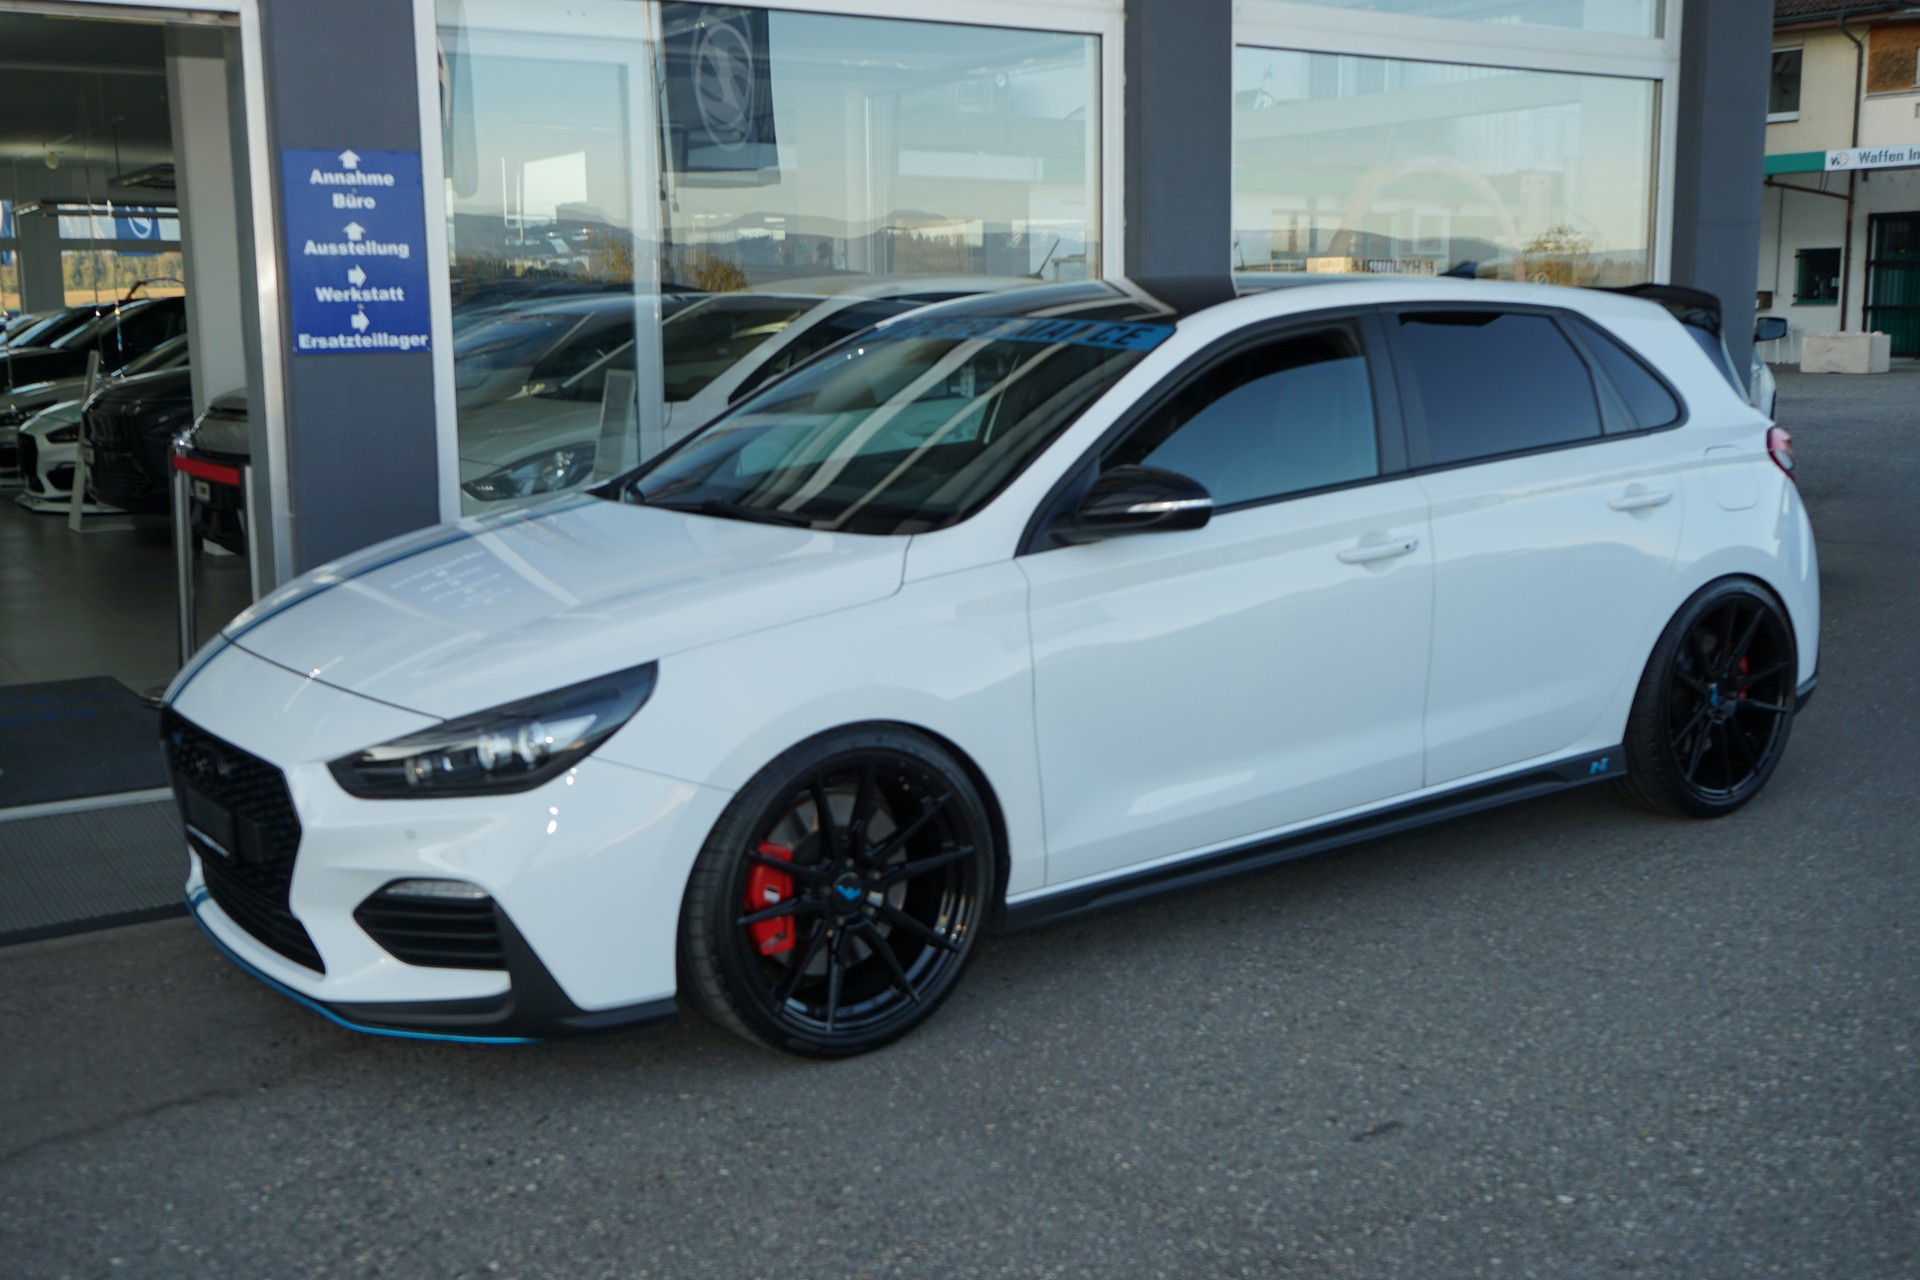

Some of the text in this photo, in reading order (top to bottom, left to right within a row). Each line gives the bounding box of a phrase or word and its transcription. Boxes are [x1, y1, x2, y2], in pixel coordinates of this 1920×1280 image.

[1859, 149, 1904, 163] Waffen
[309, 168, 395, 187] Annahme
[332, 192, 376, 209] Büro
[303, 240, 410, 259] Ausstellung
[315, 286, 405, 302] Werkstatt
[298, 332, 428, 350] Ersatzteillager
